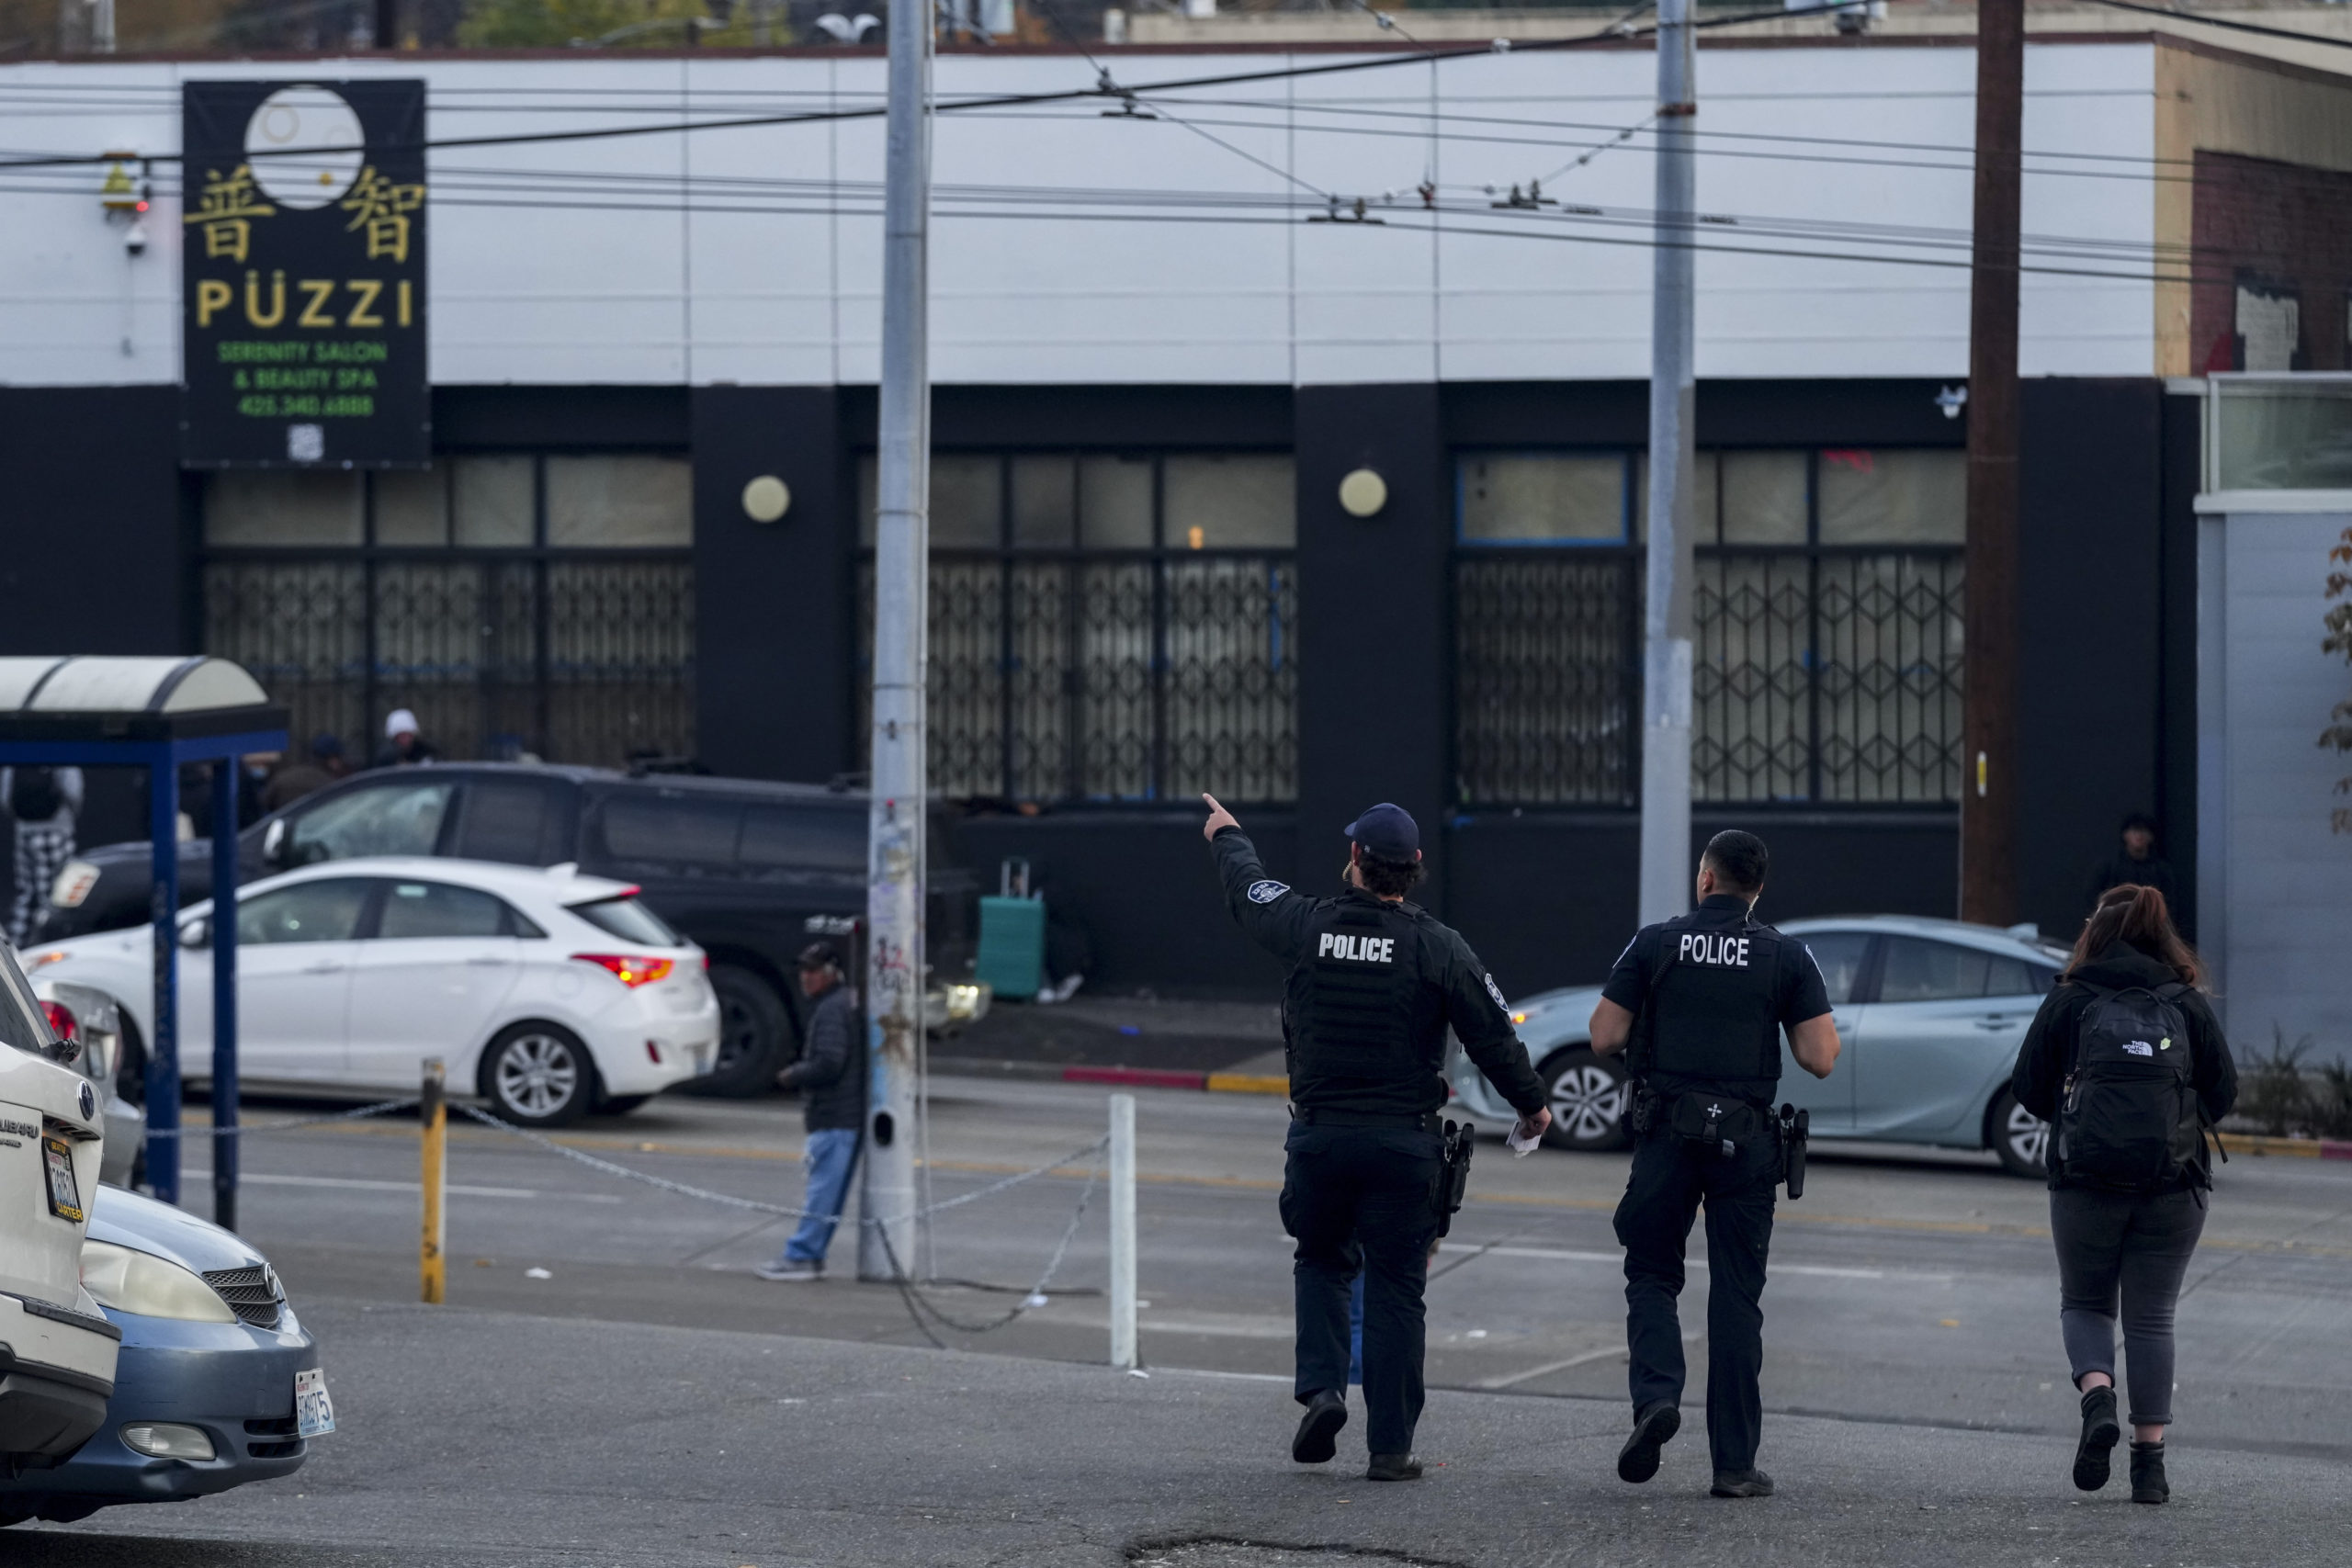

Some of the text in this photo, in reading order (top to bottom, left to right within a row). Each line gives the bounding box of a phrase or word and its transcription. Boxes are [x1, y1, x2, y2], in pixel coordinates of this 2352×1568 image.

[184, 164, 425, 263] 普 智
[197, 269, 413, 327] PÜZZI
[217, 341, 388, 362] SERENITY SALON
[233, 368, 378, 389] & BEAUTY SPA
[1318, 932, 1395, 963] POLICE
[1679, 934, 1749, 966] POLICE
[57, 1202, 83, 1220] CARTER
